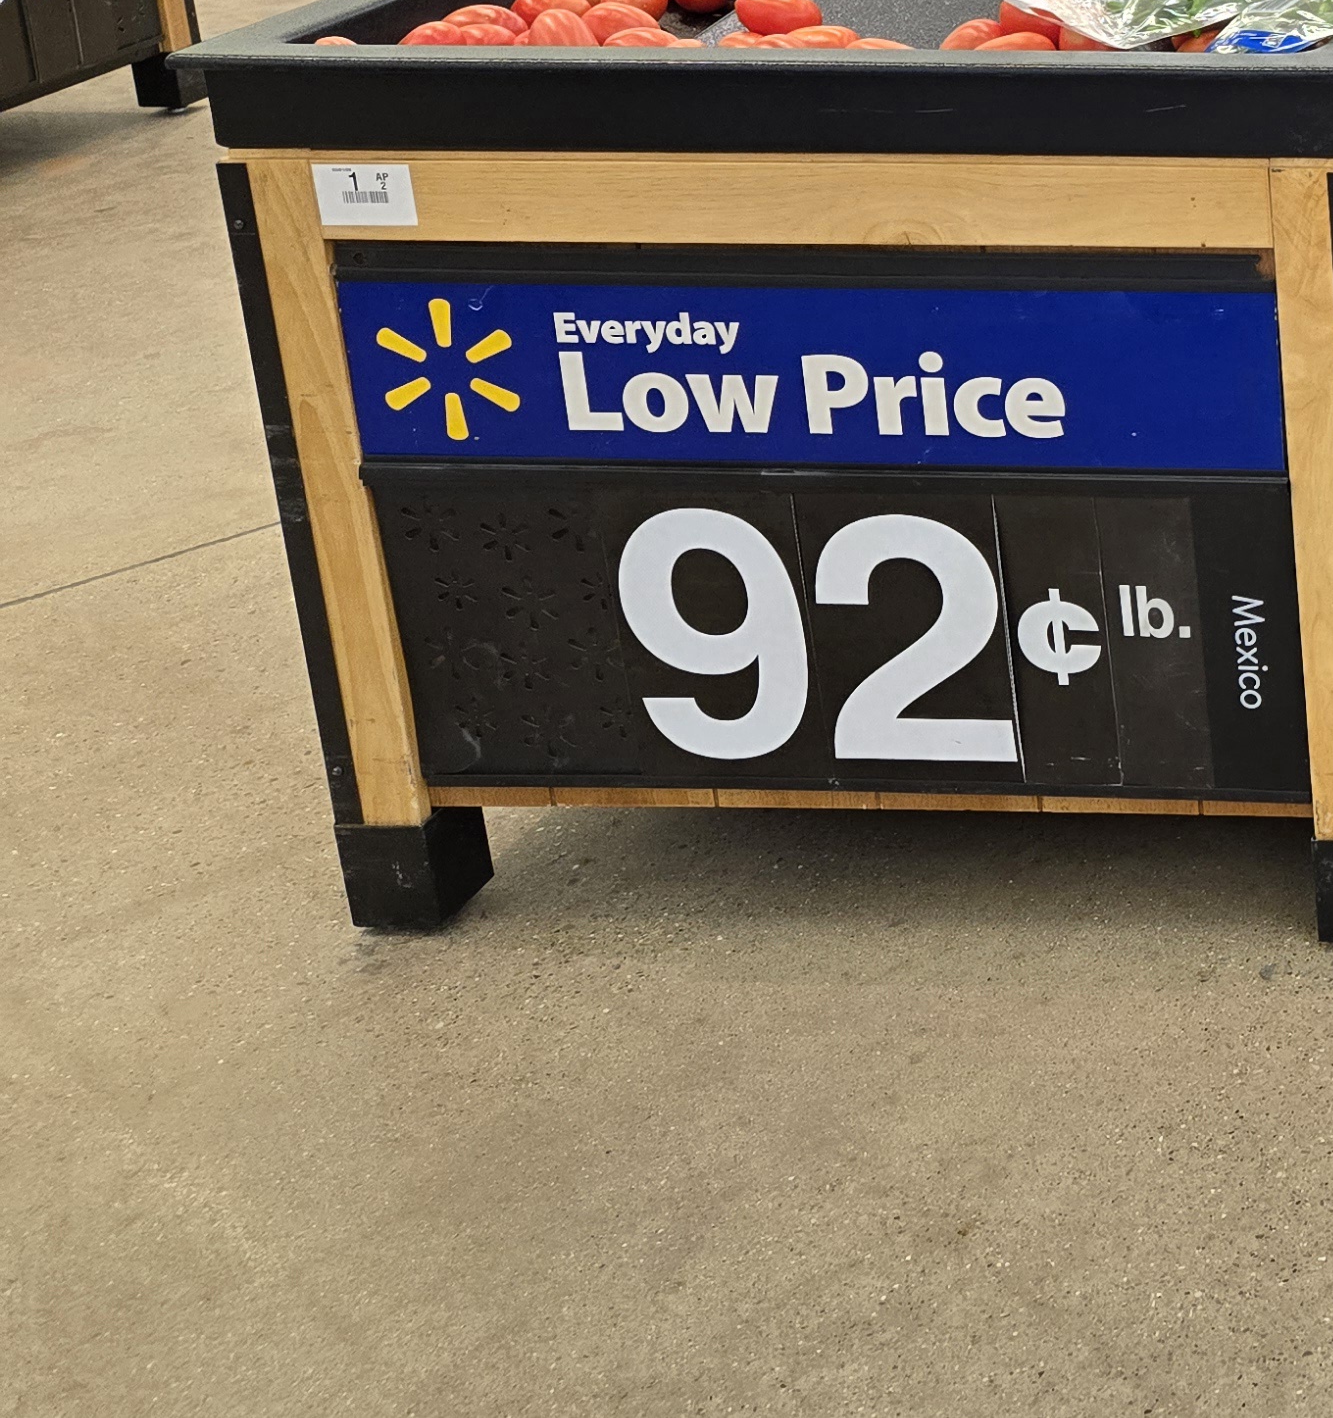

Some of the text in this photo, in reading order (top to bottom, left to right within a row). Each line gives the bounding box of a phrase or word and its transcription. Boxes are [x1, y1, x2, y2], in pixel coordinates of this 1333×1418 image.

[348, 171, 359, 192] 1
[375, 172, 389, 182] AP
[380, 181, 388, 191] 2
[554, 312, 740, 355] Everyday
[559, 350, 1066, 440] Low Price
[1118, 584, 1192, 641] lb.
[1230, 593, 1265, 711] Mexico
